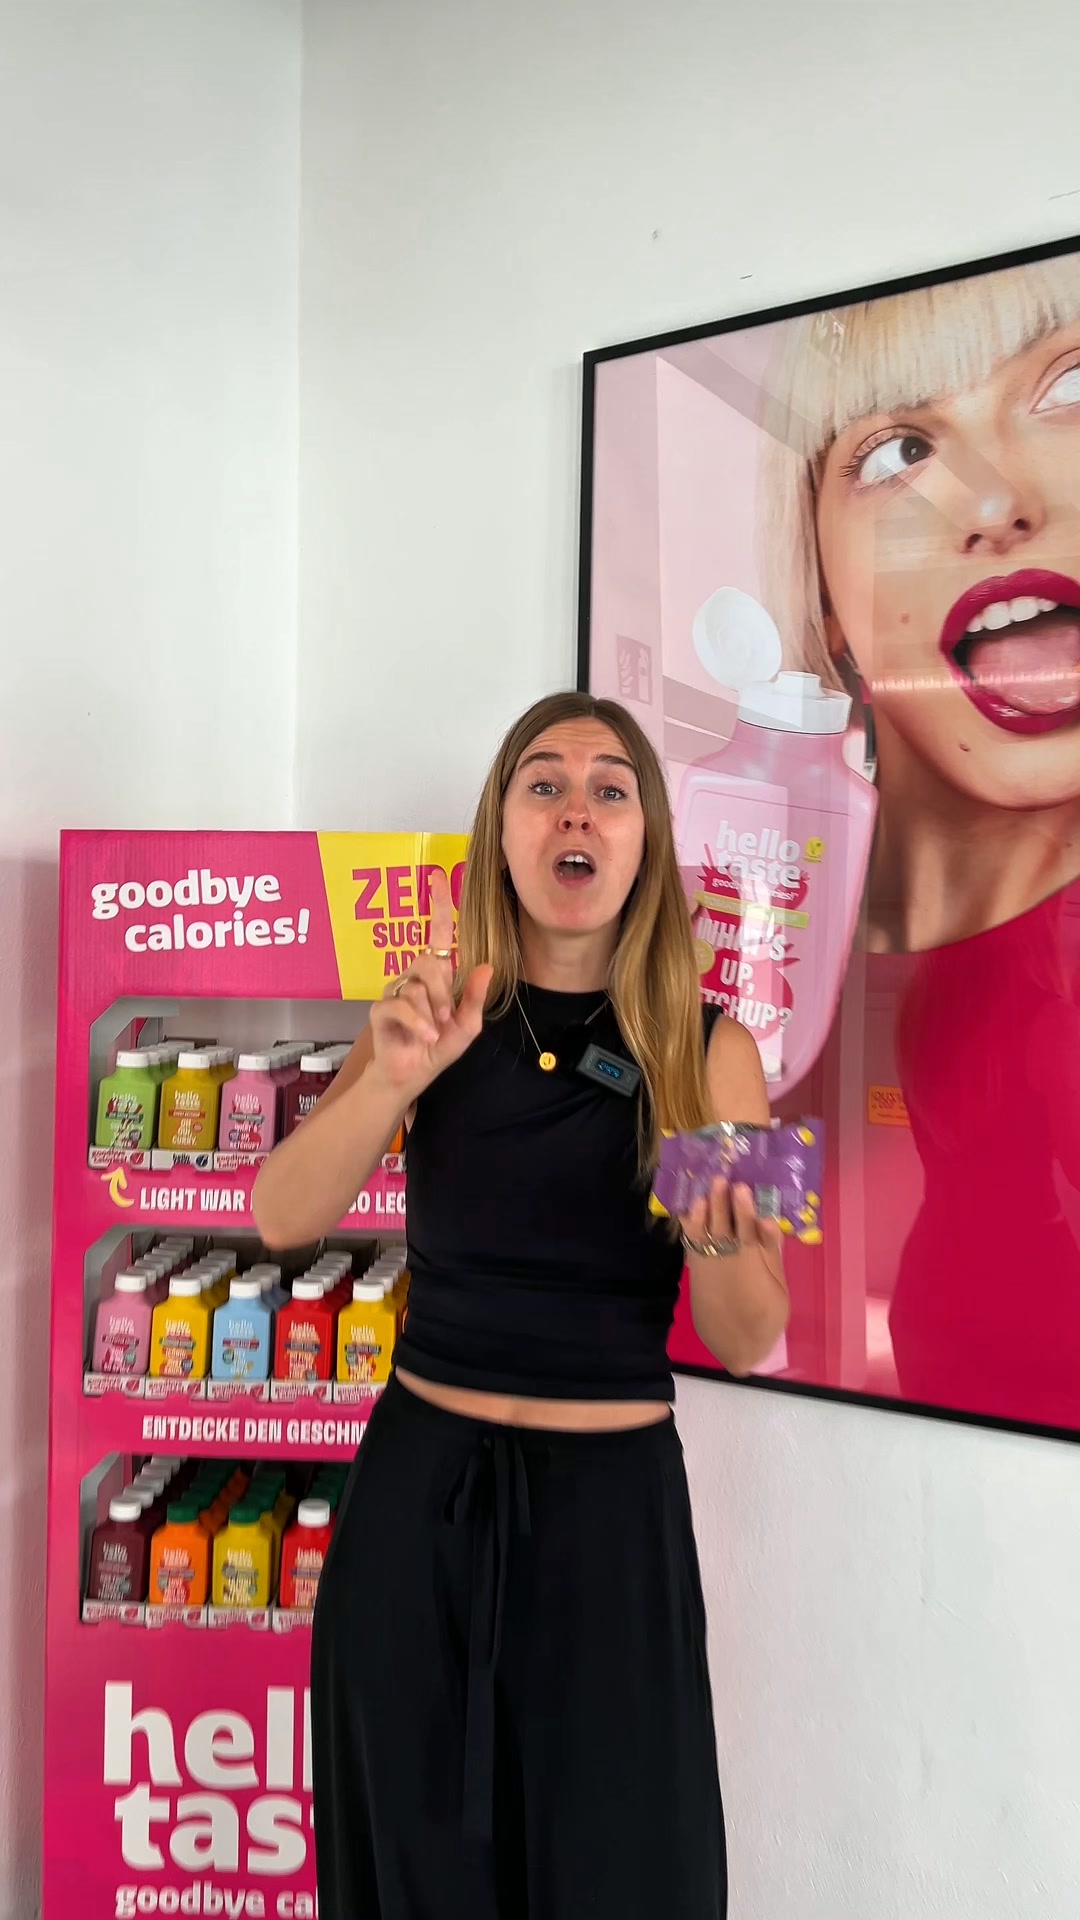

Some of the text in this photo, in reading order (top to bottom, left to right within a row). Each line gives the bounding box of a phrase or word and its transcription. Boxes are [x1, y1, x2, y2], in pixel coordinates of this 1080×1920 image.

[716, 820, 801, 863] hello
[717, 848, 802, 889] taste
[91, 868, 282, 920] goodbye
[124, 907, 311, 953] calories!
[372, 920, 457, 948] SUG
[720, 957, 756, 996] UP,
[700, 986, 794, 1033] TCHUP?
[174, 1089, 200, 1100] hello
[140, 1187, 246, 1212] LIGHT WAR
[142, 1415, 241, 1443] ENTDECKE
[244, 1418, 283, 1444] DEN
[113, 1781, 315, 1877] tas
[114, 1880, 319, 1920] goodbye ca
